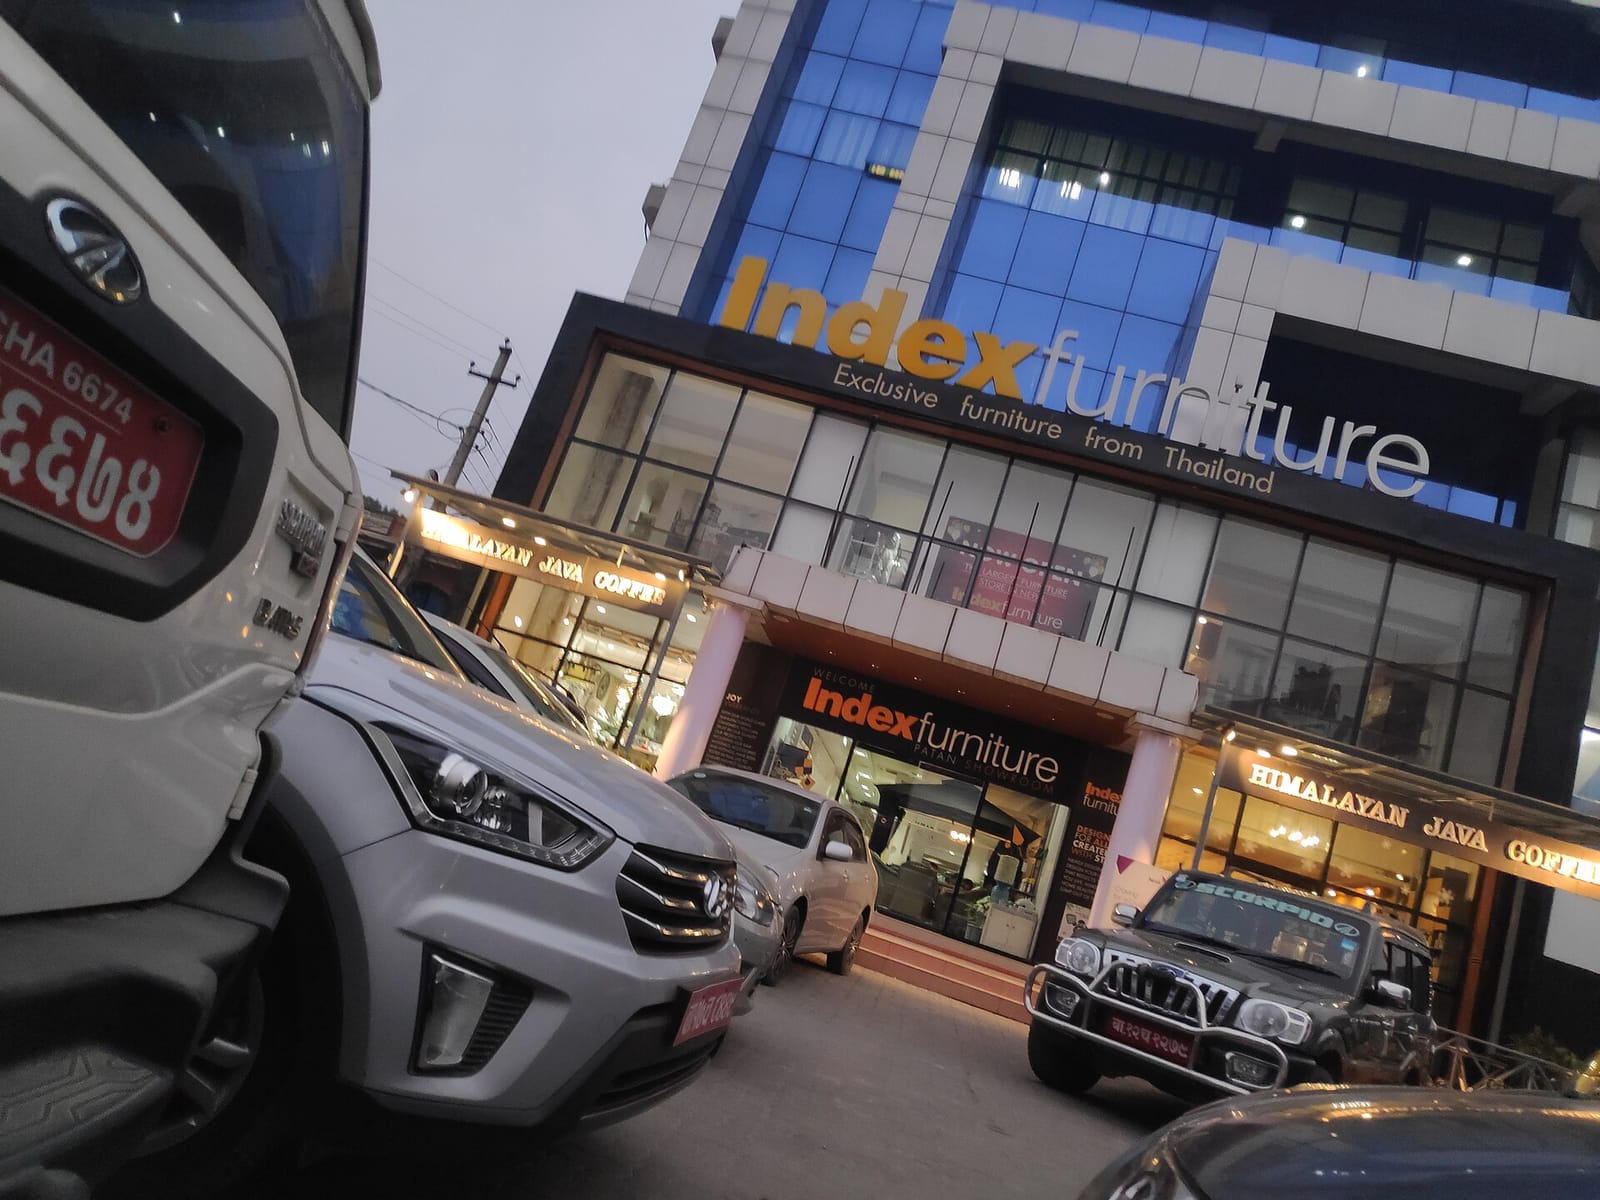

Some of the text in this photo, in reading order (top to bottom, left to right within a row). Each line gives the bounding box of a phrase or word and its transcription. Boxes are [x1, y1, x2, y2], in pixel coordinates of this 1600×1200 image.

[0, 310, 132, 424] HA 6674
[832, 363, 1275, 494] Exclusive furniture from Thailand
[420, 510, 666, 606] LAYAN JAVA COFFEE
[981, 567, 1020, 583] LARGES
[1021, 578, 1069, 598] FURNTURE
[813, 667, 876, 693] WELCOME
[912, 743, 1055, 794] PATAN SHOWROOM
[1083, 795, 1120, 817] furnitu
[1084, 781, 1121, 804] Inde
[1248, 763, 1409, 828] HIMALAYAN
[1423, 816, 1488, 852] JAVA
[1072, 839, 1107, 857] CREATE
[1094, 854, 1106, 864] ST
[1193, 882, 1335, 928] SCORPIO
